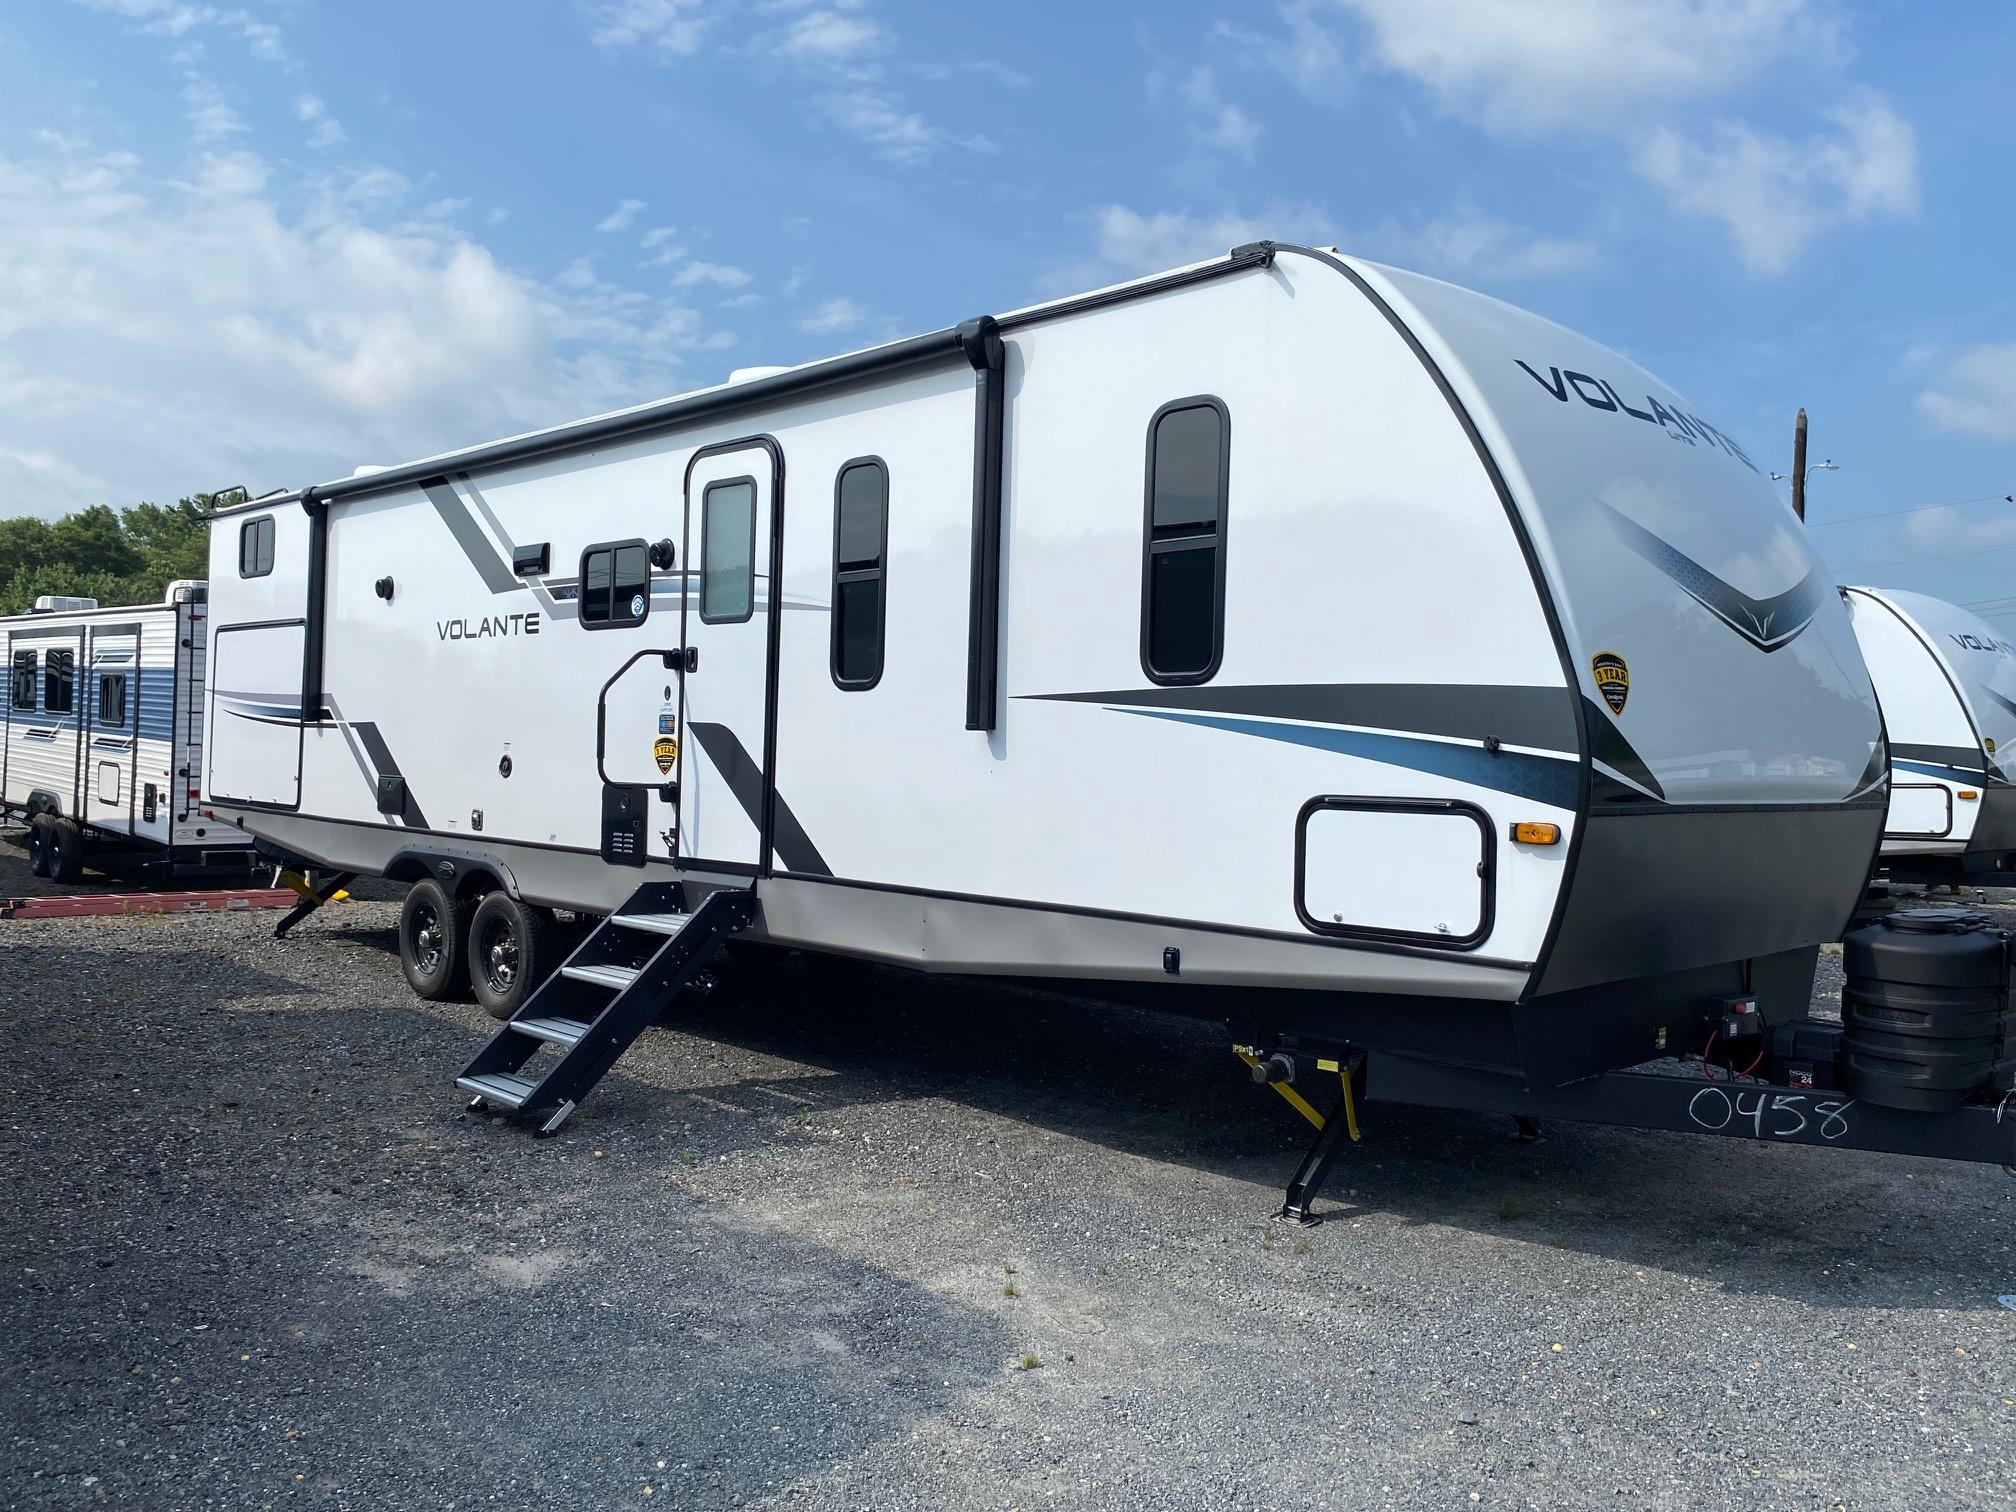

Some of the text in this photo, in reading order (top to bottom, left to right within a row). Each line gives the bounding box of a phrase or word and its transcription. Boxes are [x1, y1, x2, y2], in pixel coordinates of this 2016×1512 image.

[1513, 359, 1760, 475] VOLANTE
[436, 612, 540, 641] VOLANTE
[1948, 633, 2016, 656] VOLANT
[1596, 668, 1627, 683] 3 YEAR
[1800, 1075, 1813, 1085] 24
[1688, 1087, 1857, 1140] 0458
